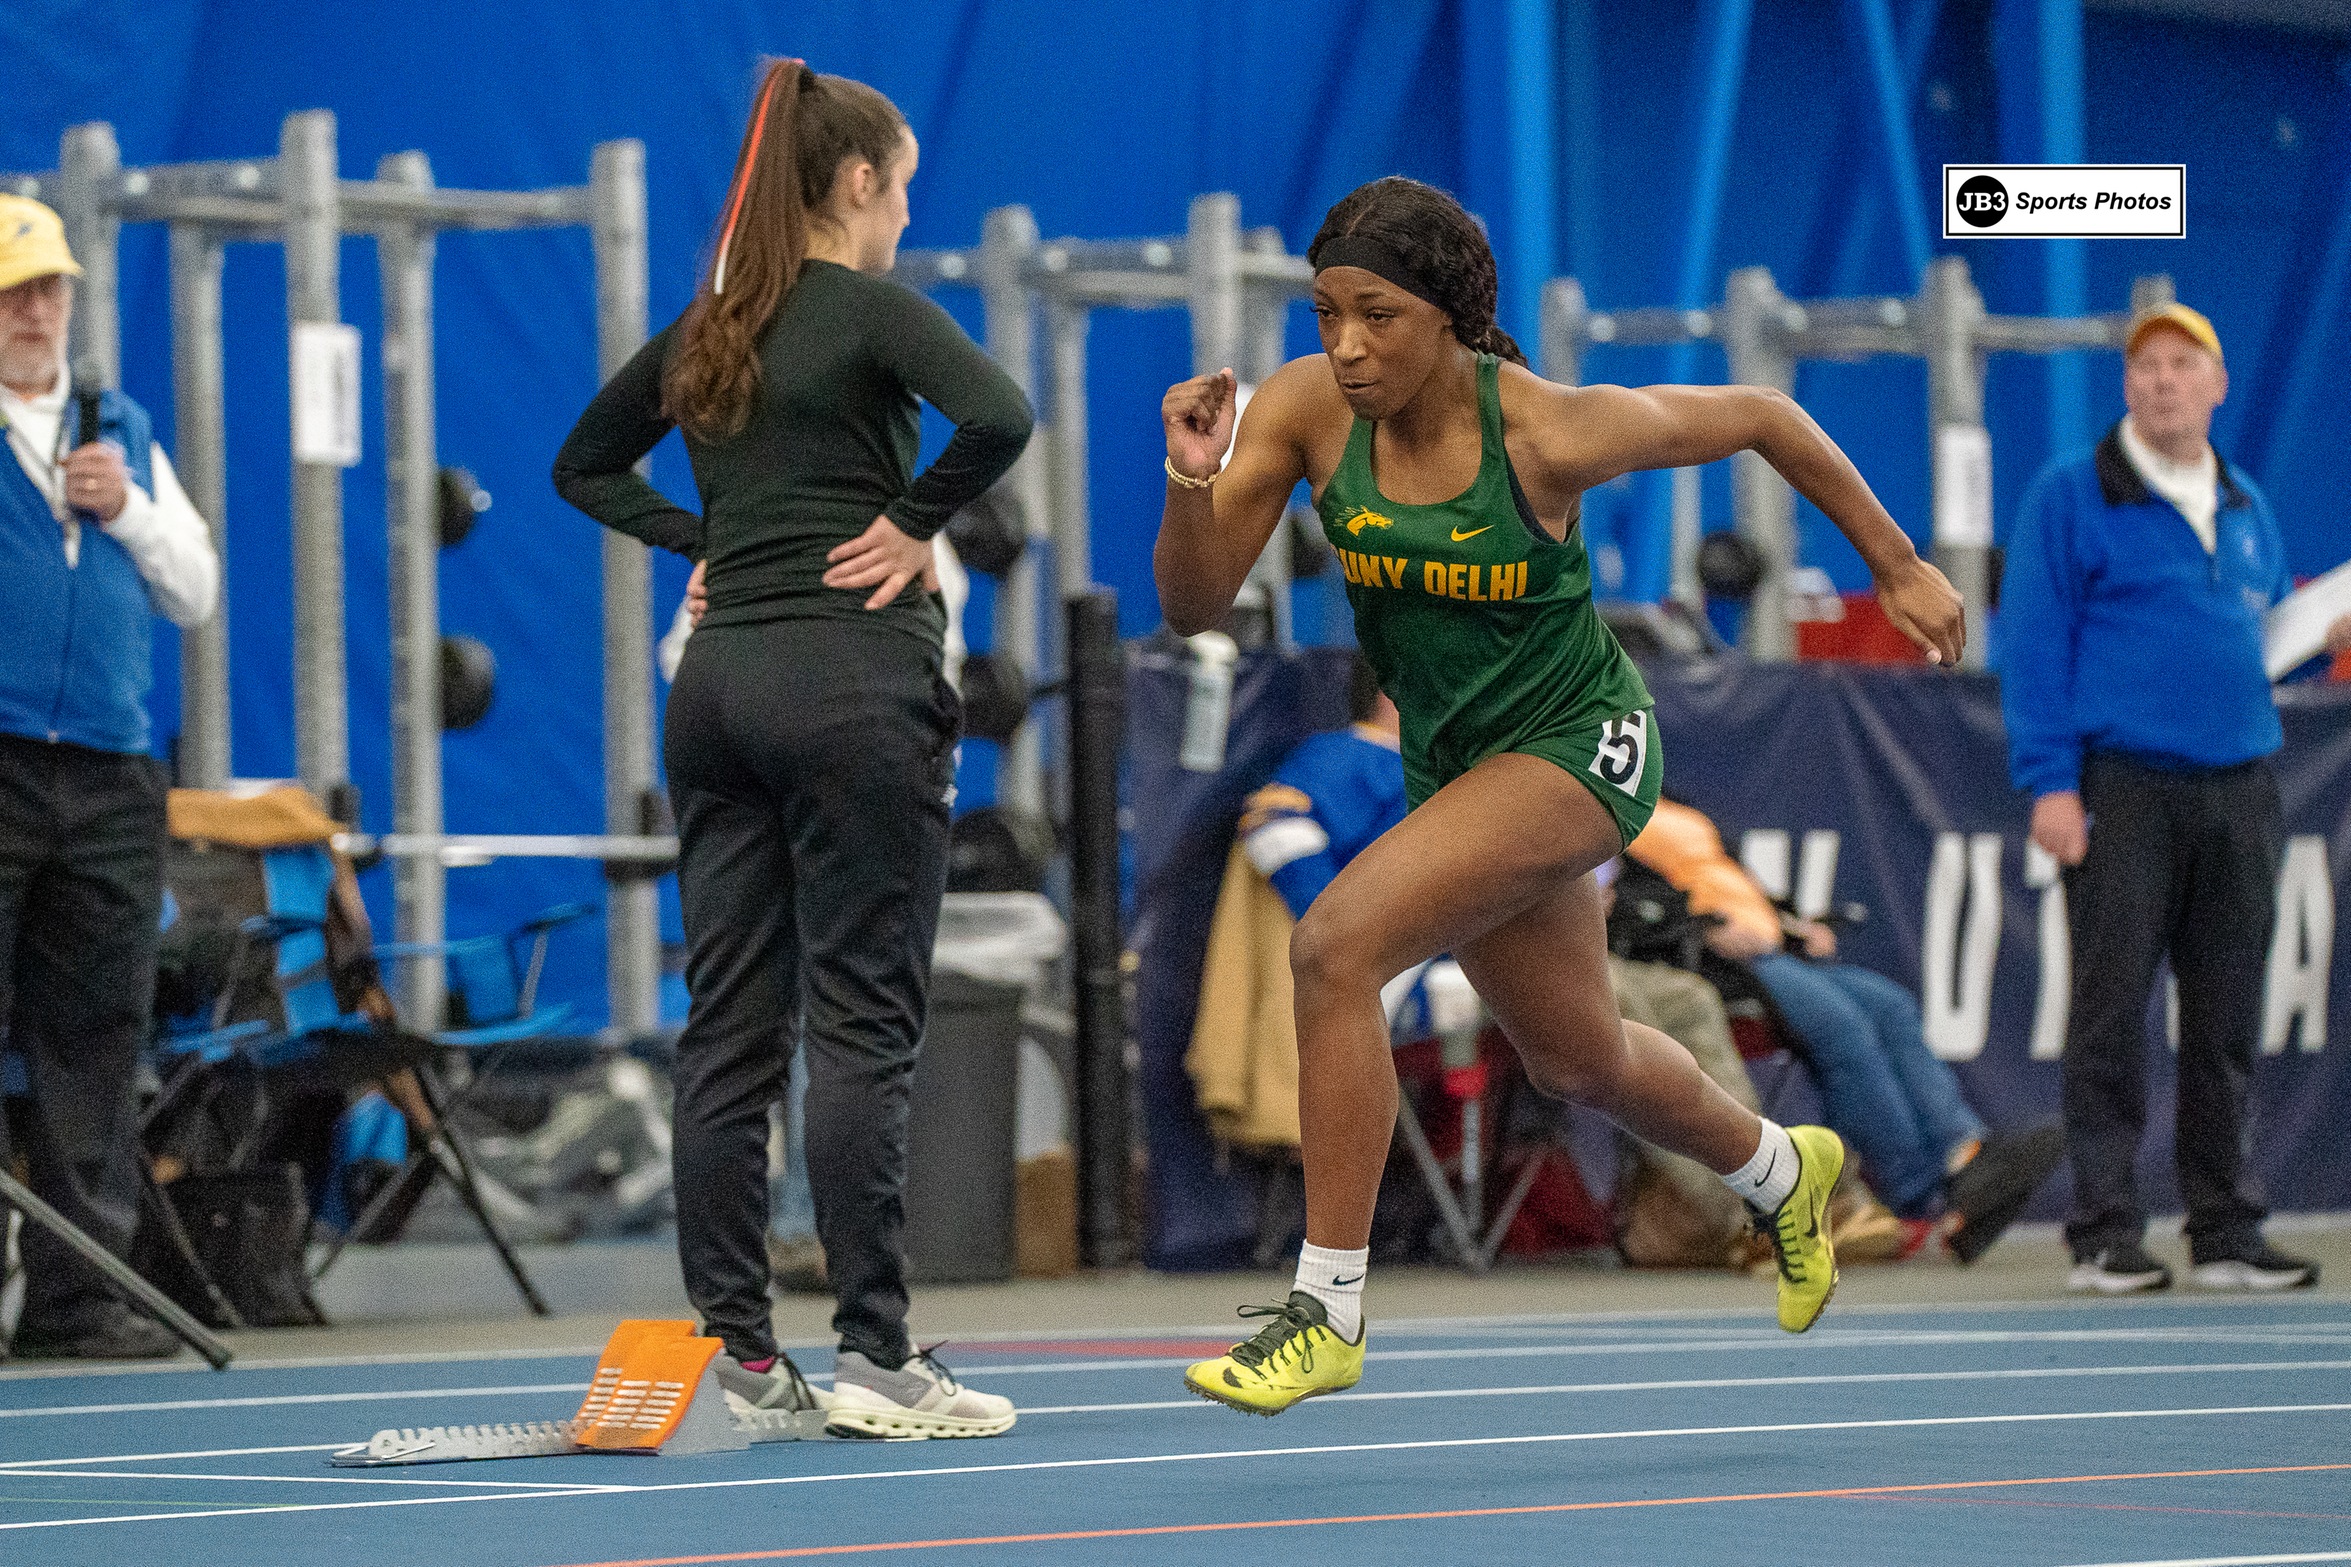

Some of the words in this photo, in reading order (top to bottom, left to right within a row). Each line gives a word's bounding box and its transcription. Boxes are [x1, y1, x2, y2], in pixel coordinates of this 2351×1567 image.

[1332, 545, 1408, 589] UNY
[1423, 560, 1528, 601] DELHI
[1599, 712, 1641, 786] 5
